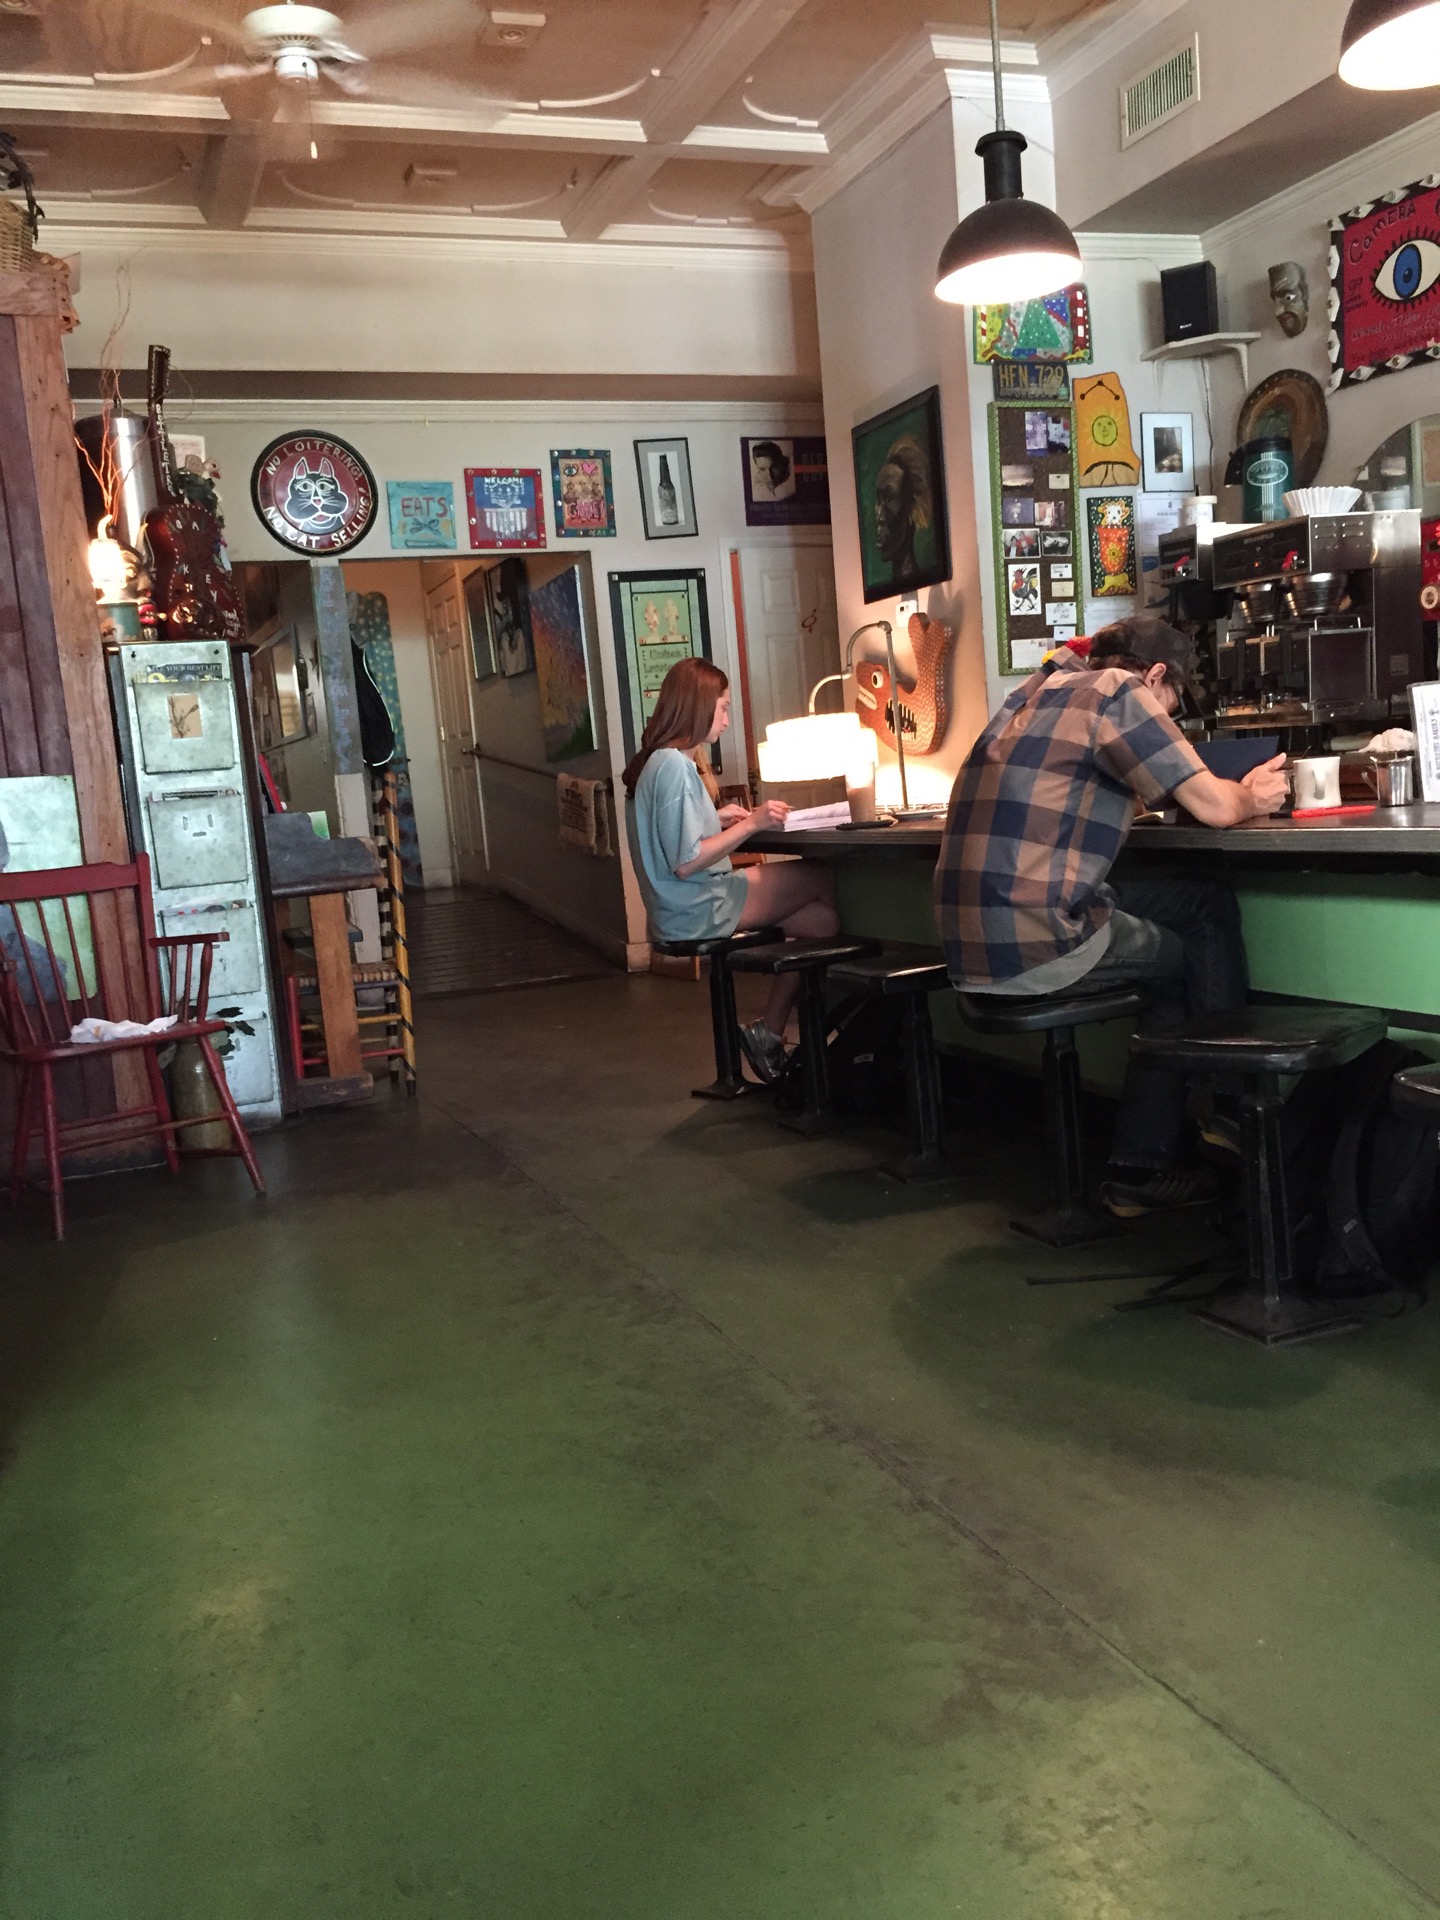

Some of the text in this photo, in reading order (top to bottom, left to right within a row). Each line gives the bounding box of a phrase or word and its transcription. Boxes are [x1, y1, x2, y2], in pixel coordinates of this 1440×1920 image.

[265, 440, 363, 481] NO LOITERING!
[263, 505, 284, 533] NO
[286, 527, 320, 549] CAT
[401, 496, 448, 518] EATS
